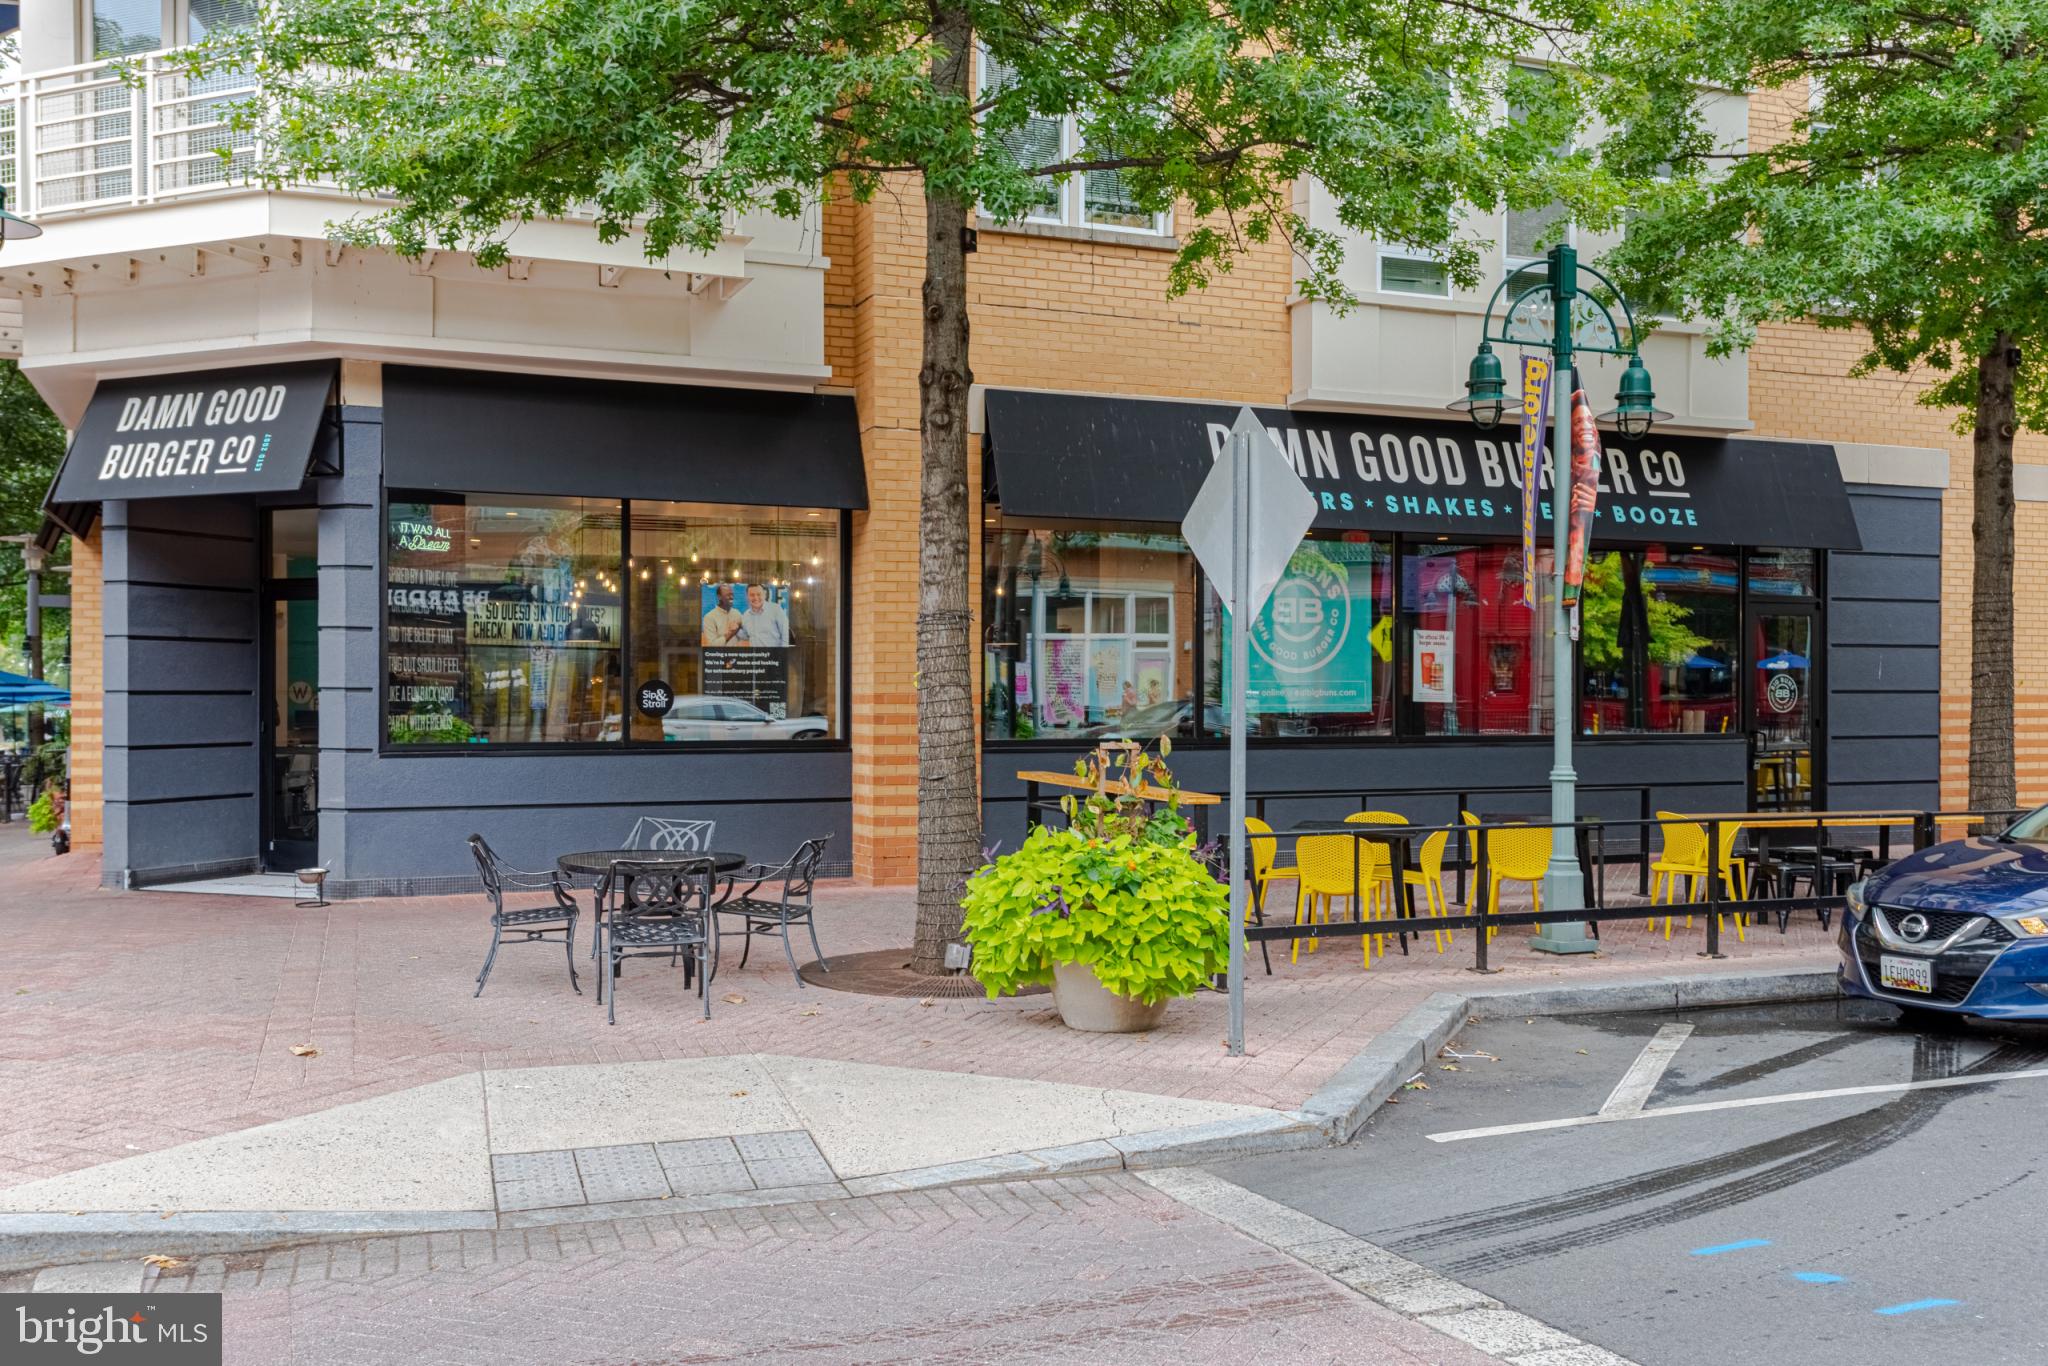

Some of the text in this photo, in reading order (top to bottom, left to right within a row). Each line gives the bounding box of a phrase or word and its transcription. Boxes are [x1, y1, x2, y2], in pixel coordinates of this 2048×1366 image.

[116, 384, 287, 433] DAMN GOOD
[98, 434, 257, 480] BURGER CO
[1206, 422, 1340, 479] DMN
[1349, 431, 1467, 486] GOOD
[1640, 449, 1685, 487] CO
[1385, 494, 1698, 526] SHAKES BOOZE
[410, 523, 433, 535] WAS
[434, 527, 452, 539] ALL
[408, 534, 451, 552] Dream
[486, 601, 499, 620] SO
[436, 628, 455, 645] THAT
[473, 621, 507, 639] CHECK!
[511, 622, 534, 641] NOW
[403, 656, 417, 673] OUT
[417, 657, 443, 673] SHOULD
[443, 657, 460, 673] FEEL
[292, 685, 308, 699] W
[642, 699, 666, 708] Stroll
